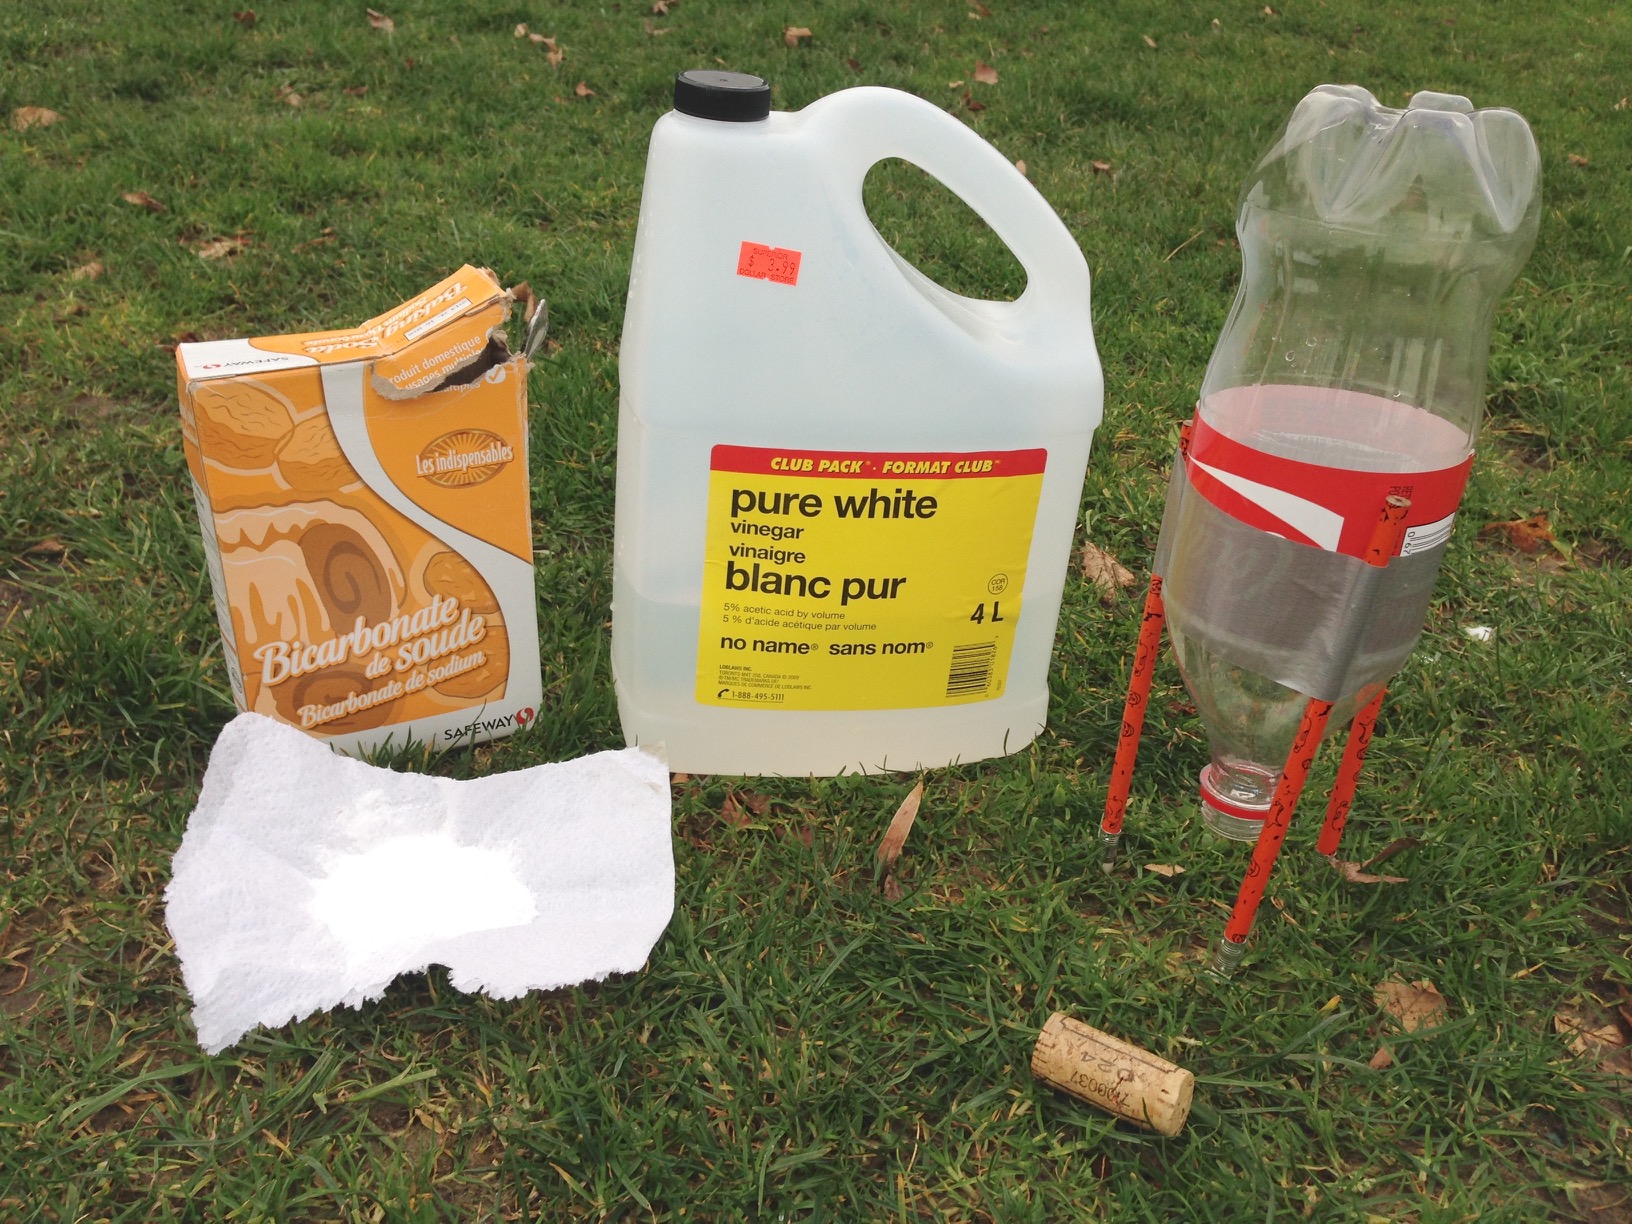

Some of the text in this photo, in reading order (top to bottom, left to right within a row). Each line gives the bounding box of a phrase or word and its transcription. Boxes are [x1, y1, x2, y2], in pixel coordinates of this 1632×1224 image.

[739, 267, 795, 284] DOLLAR STORE
[767, 258, 796, 276] 3.99
[383, 282, 468, 338] Baking
[304, 336, 379, 354] Soda
[224, 356, 289, 368] SAFEWAY
[388, 335, 481, 384] roduit domestique
[415, 441, 513, 475] Les indispensables
[770, 457, 814, 472] CLUB
[882, 461, 952, 474] FORMAT
[731, 488, 938, 519] pure white
[730, 520, 805, 540] vinegar
[728, 542, 806, 564] vinaigre
[725, 560, 907, 606] blanc pur
[722, 614, 877, 631] 5 % d'acide acétique par volume
[723, 602, 846, 620] 5% acetic acid by volume
[970, 600, 1004, 624] 4 L
[254, 593, 460, 686] Bicarbonate
[365, 607, 487, 679] de soude
[720, 636, 747, 650] no
[828, 642, 877, 655] sans
[297, 650, 487, 729] Bicarbonate de sodium
[444, 713, 514, 741] SAFEWAY
